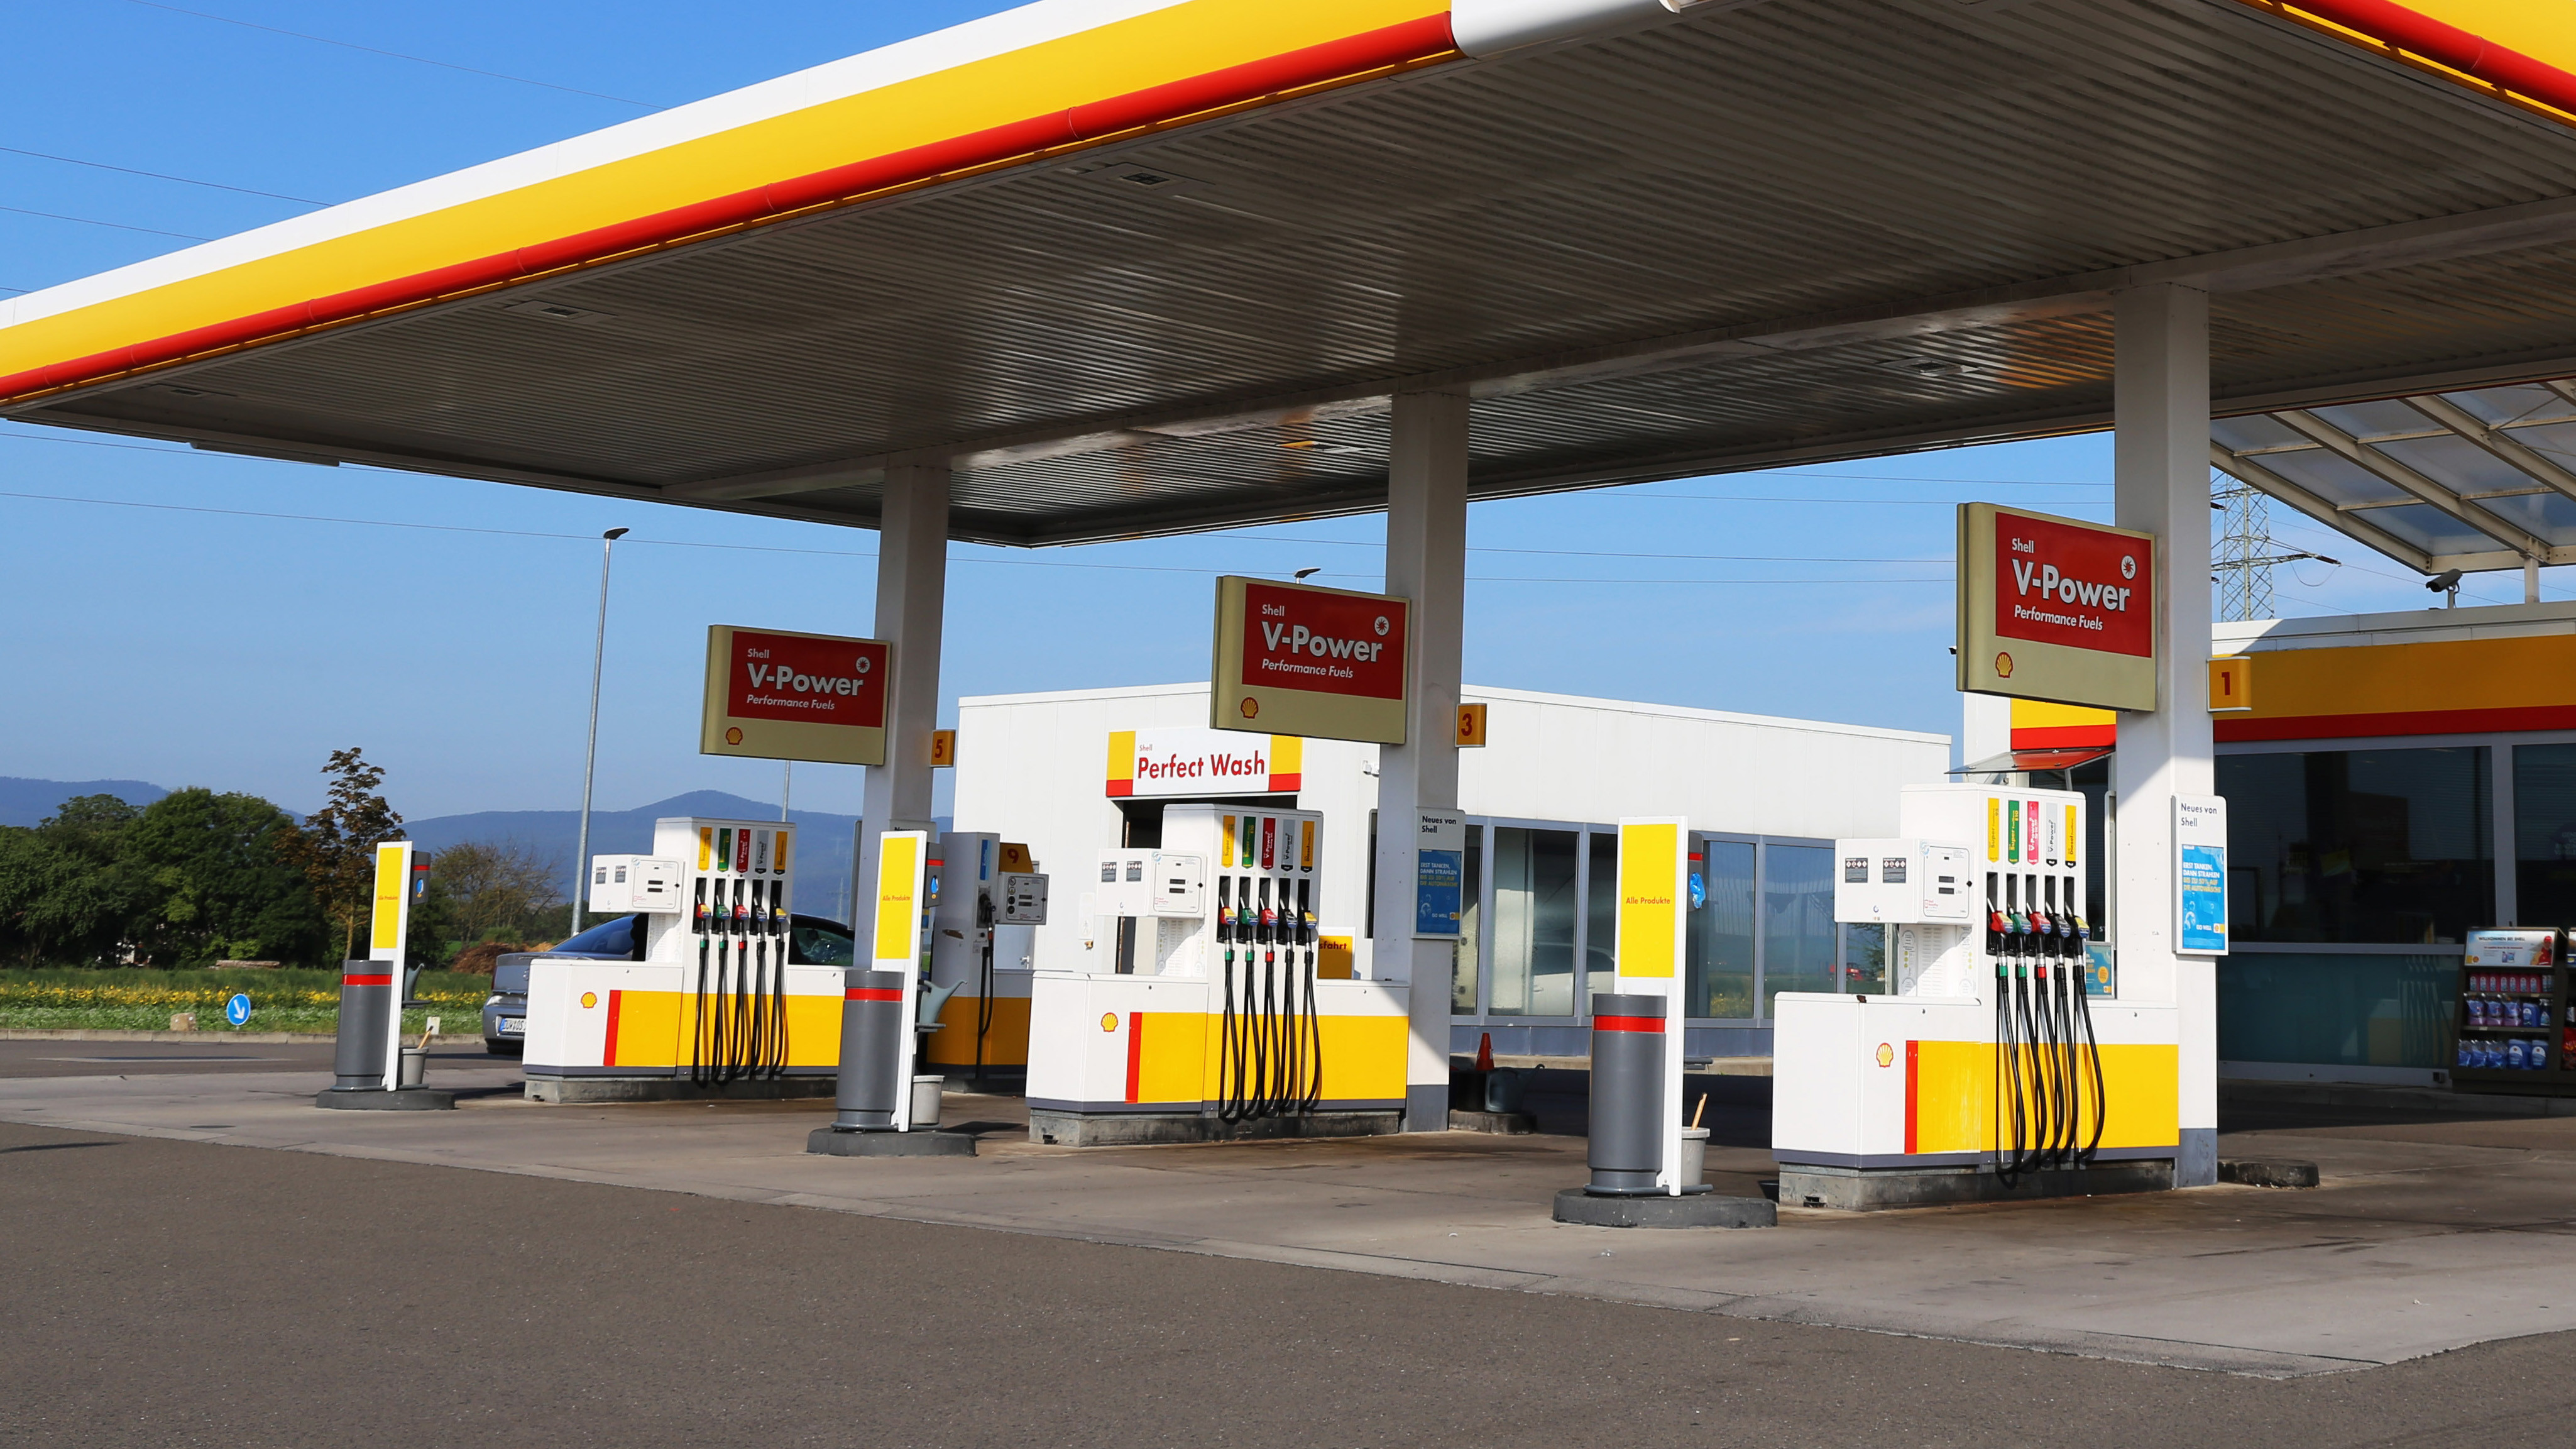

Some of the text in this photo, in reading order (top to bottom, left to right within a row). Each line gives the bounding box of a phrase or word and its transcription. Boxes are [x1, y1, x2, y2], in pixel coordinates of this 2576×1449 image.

[2012, 537, 2034, 554] Shell
[2012, 558, 2130, 612] V-Power
[1262, 603, 1285, 617] Shell
[2014, 604, 2103, 631] Performance Fuels
[1261, 620, 1383, 663] V-Power
[747, 648, 769, 659] Shell
[1262, 658, 1354, 678] Performance Fuels
[747, 663, 863, 697] V-Power
[2222, 671, 2230, 695] 1
[747, 694, 835, 710] Performance Fuels
[1461, 713, 1472, 737] 3
[934, 739, 943, 758] 5
[1139, 744, 1153, 752] Shell
[1138, 750, 1265, 779] Perfect Wash
[2181, 803, 2203, 813] Neues
[1422, 815, 1443, 824] Neues
[2181, 817, 2198, 827] Shell
[1422, 825, 1437, 834] Shell
[1007, 848, 1019, 864] 9
